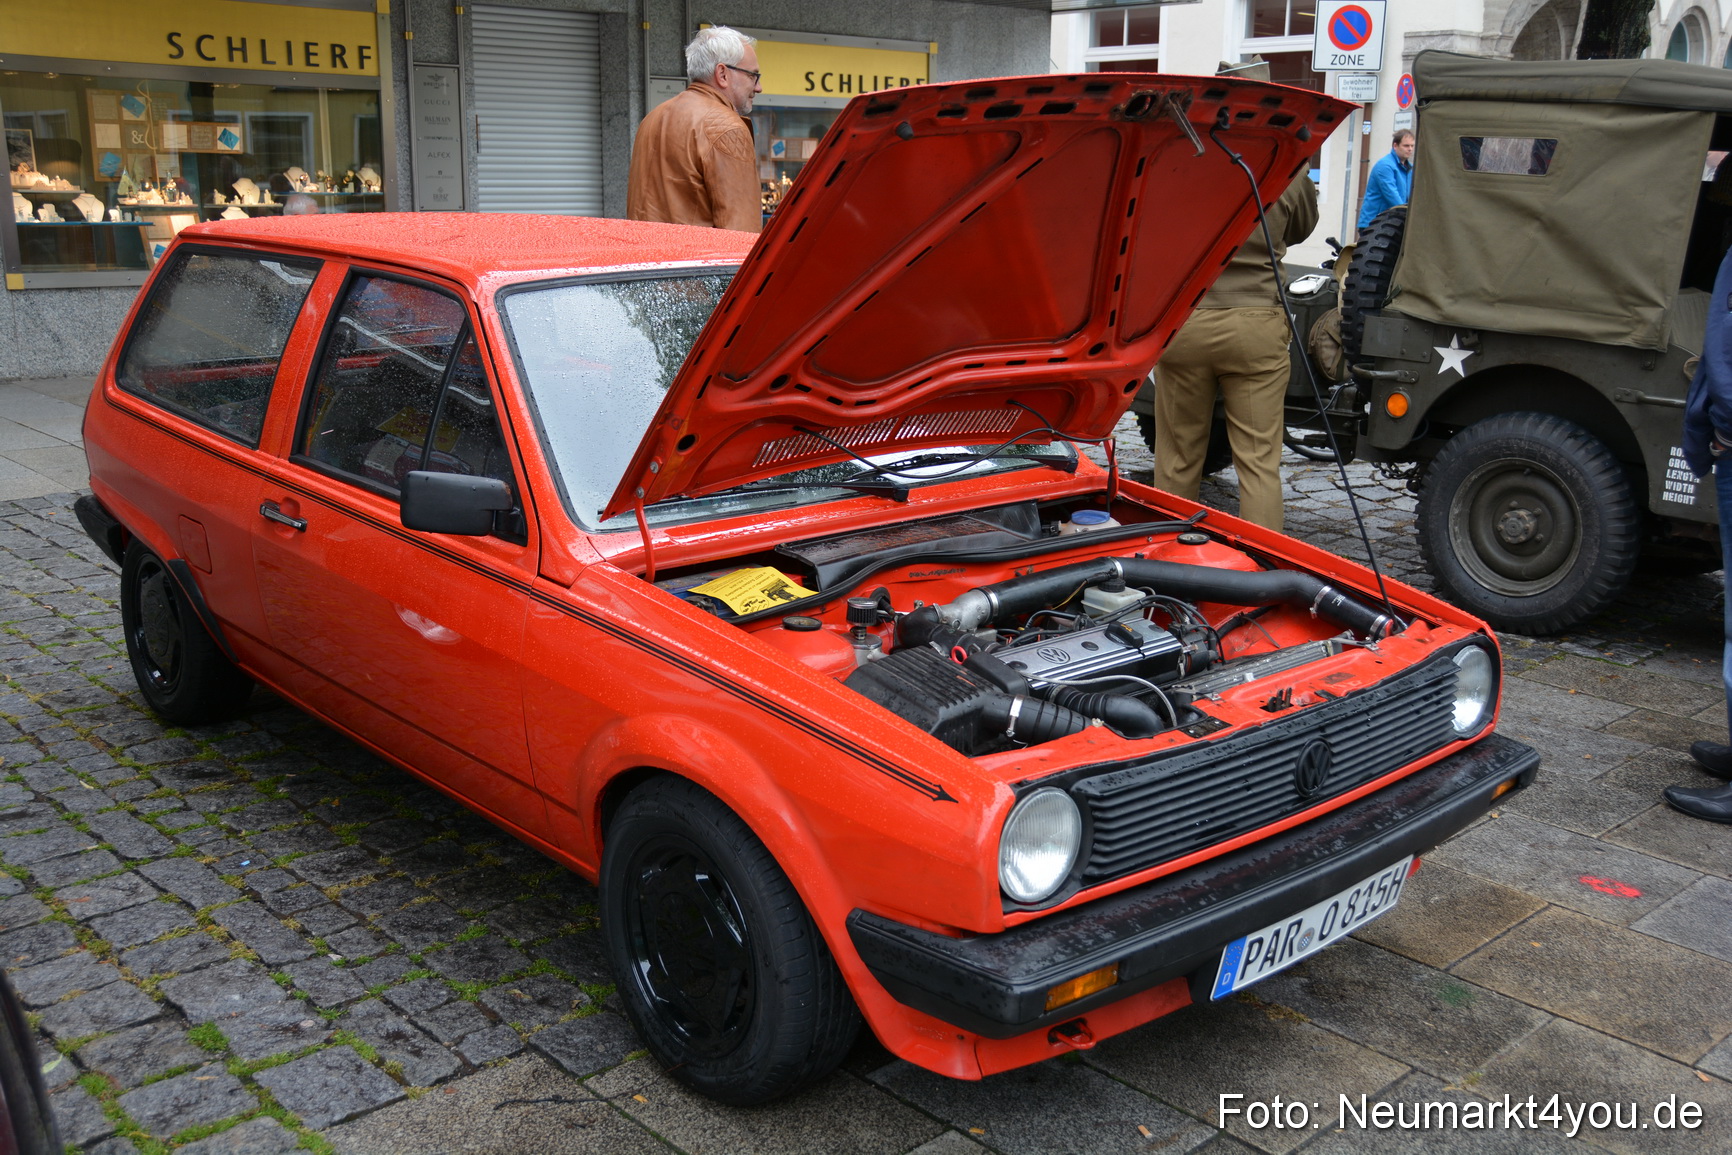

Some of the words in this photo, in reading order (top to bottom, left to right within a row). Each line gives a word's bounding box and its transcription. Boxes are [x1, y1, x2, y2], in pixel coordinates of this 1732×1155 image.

[167, 32, 372, 70] SCHLIERF
[1330, 54, 1365, 66] ZONE
[1343, 78, 1374, 86] Bewohner
[1665, 480, 1695, 494] WIDTH
[1662, 491, 1696, 505] HEIGHT
[1238, 916, 1304, 981] PAR
[1221, 972, 1231, 986] D
